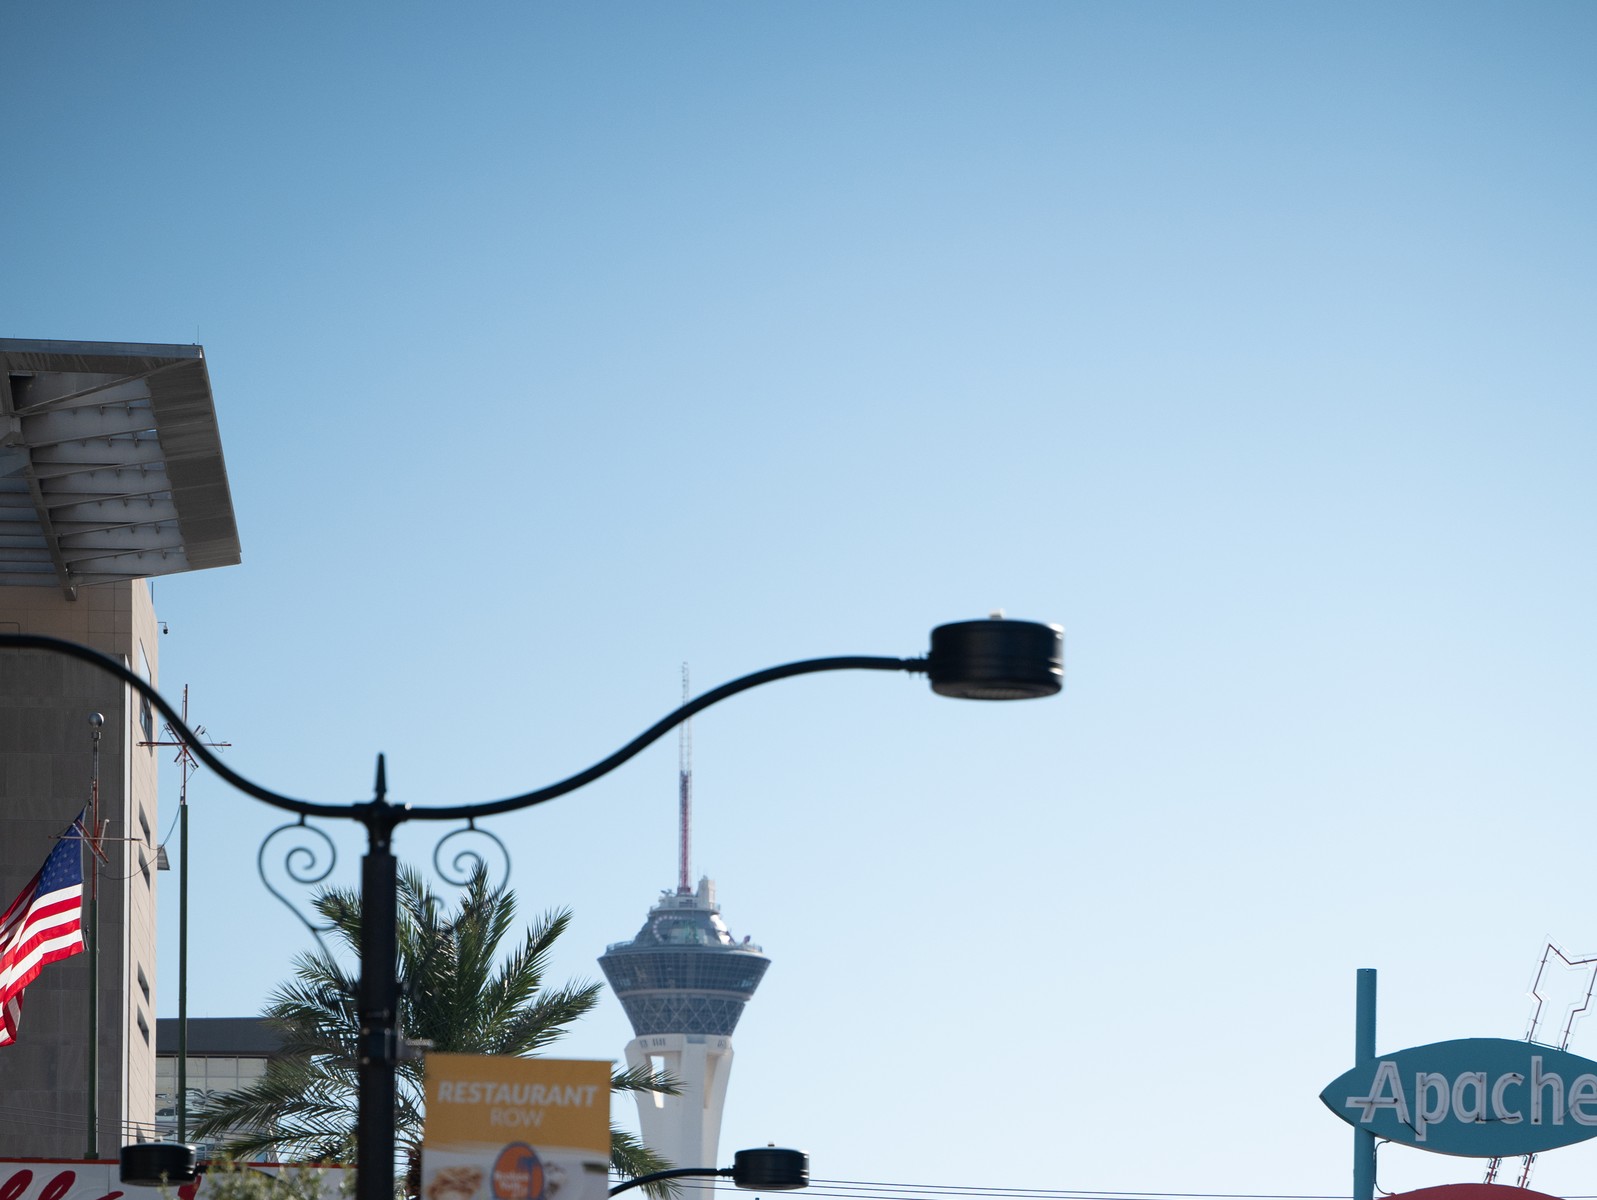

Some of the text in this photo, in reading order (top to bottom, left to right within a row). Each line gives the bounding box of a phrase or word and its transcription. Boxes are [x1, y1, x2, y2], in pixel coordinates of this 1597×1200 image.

[438, 1081, 598, 1107] RESTAURANT
[1345, 1055, 1597, 1141] Apache
[490, 1107, 545, 1128] ROW
